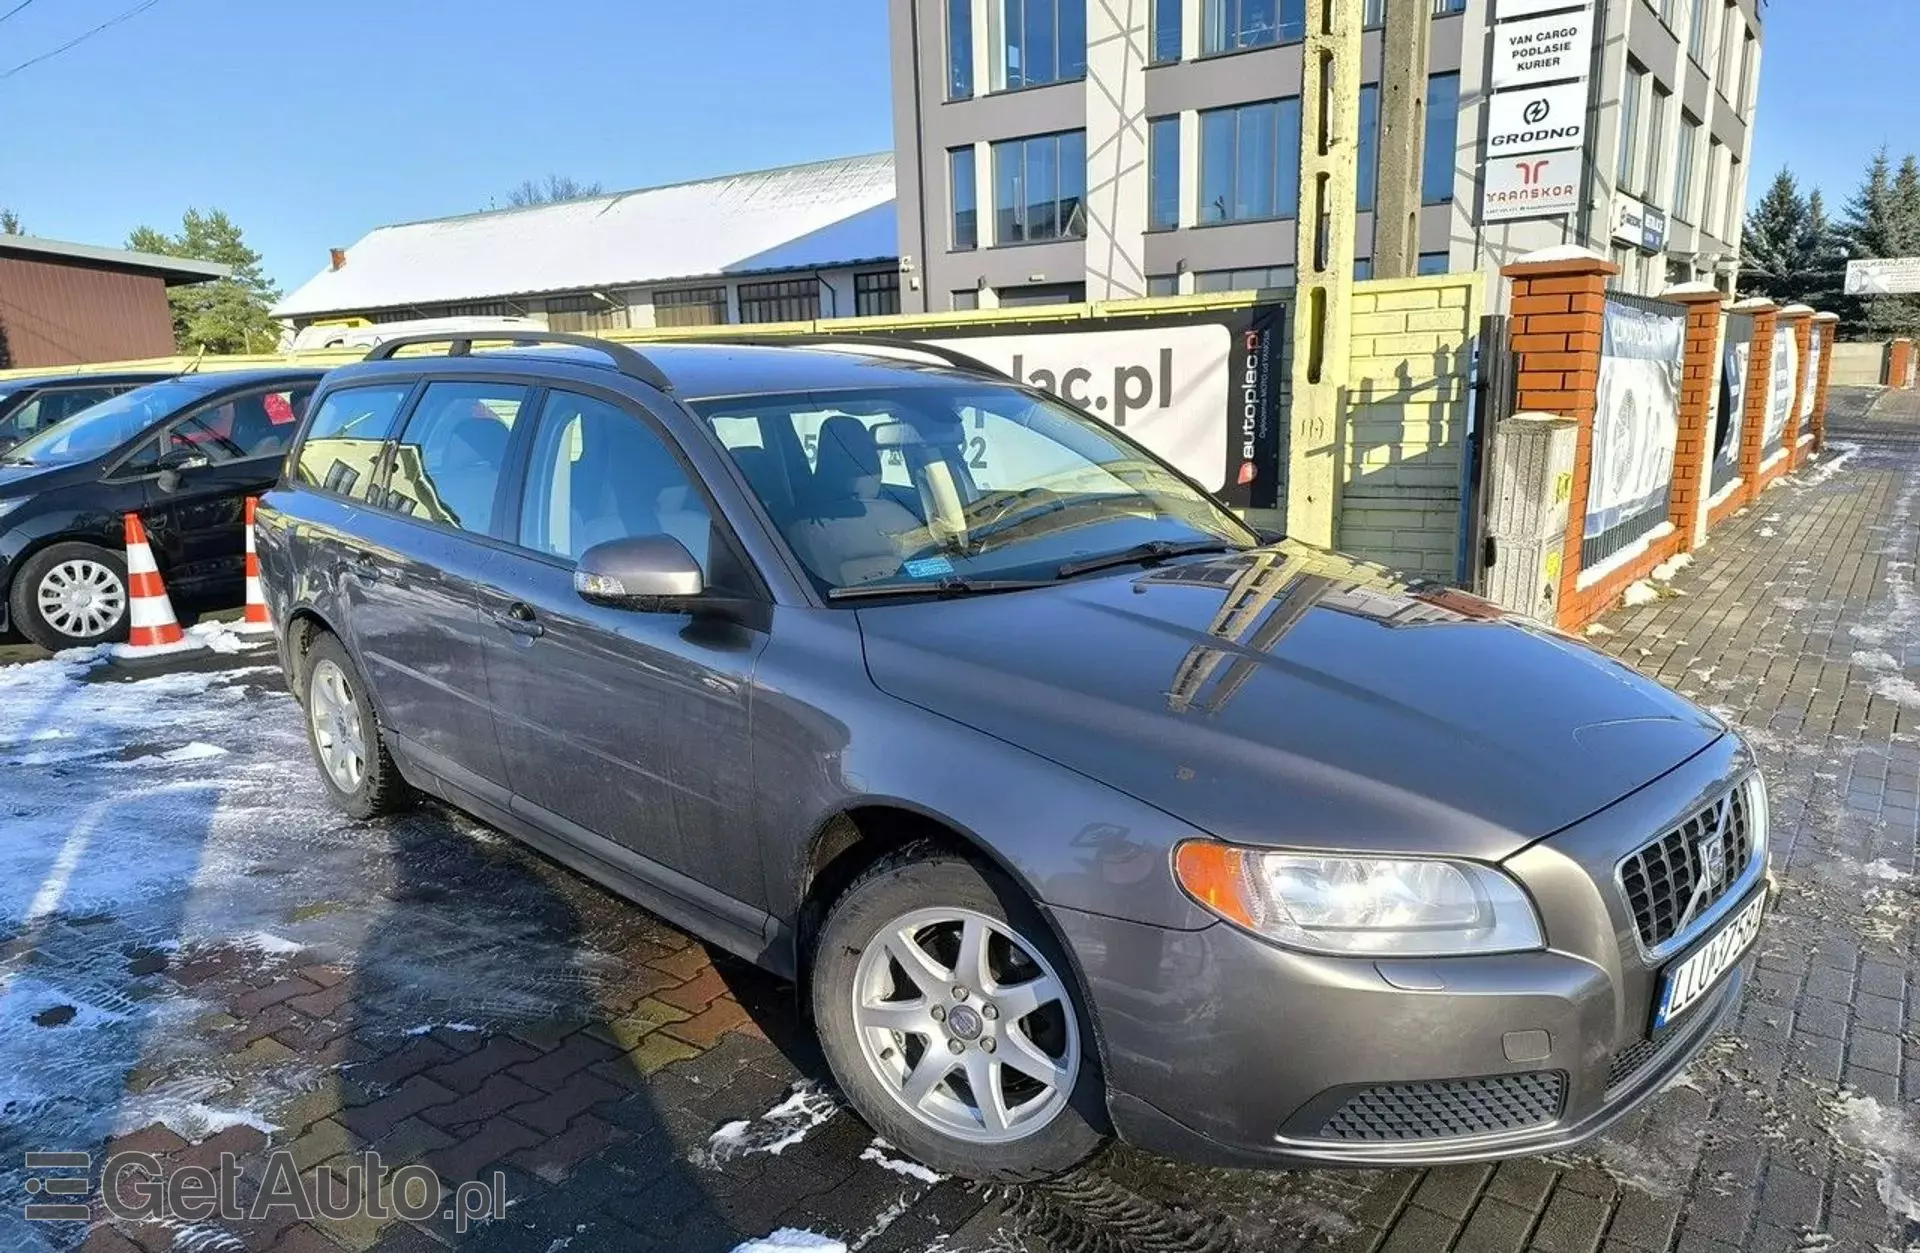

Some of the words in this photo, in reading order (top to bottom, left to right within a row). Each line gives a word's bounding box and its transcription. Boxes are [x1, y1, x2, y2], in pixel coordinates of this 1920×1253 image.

[1509, 34, 1533, 46] VAN
[1536, 26, 1578, 42] CARGO
[1512, 41, 1572, 59] PODLASIE
[1517, 57, 1560, 72] KURIER
[1491, 125, 1580, 147] GRODNO
[1486, 184, 1574, 203] TRANSKOR
[1241, 330, 1262, 459] autoplac.pl
